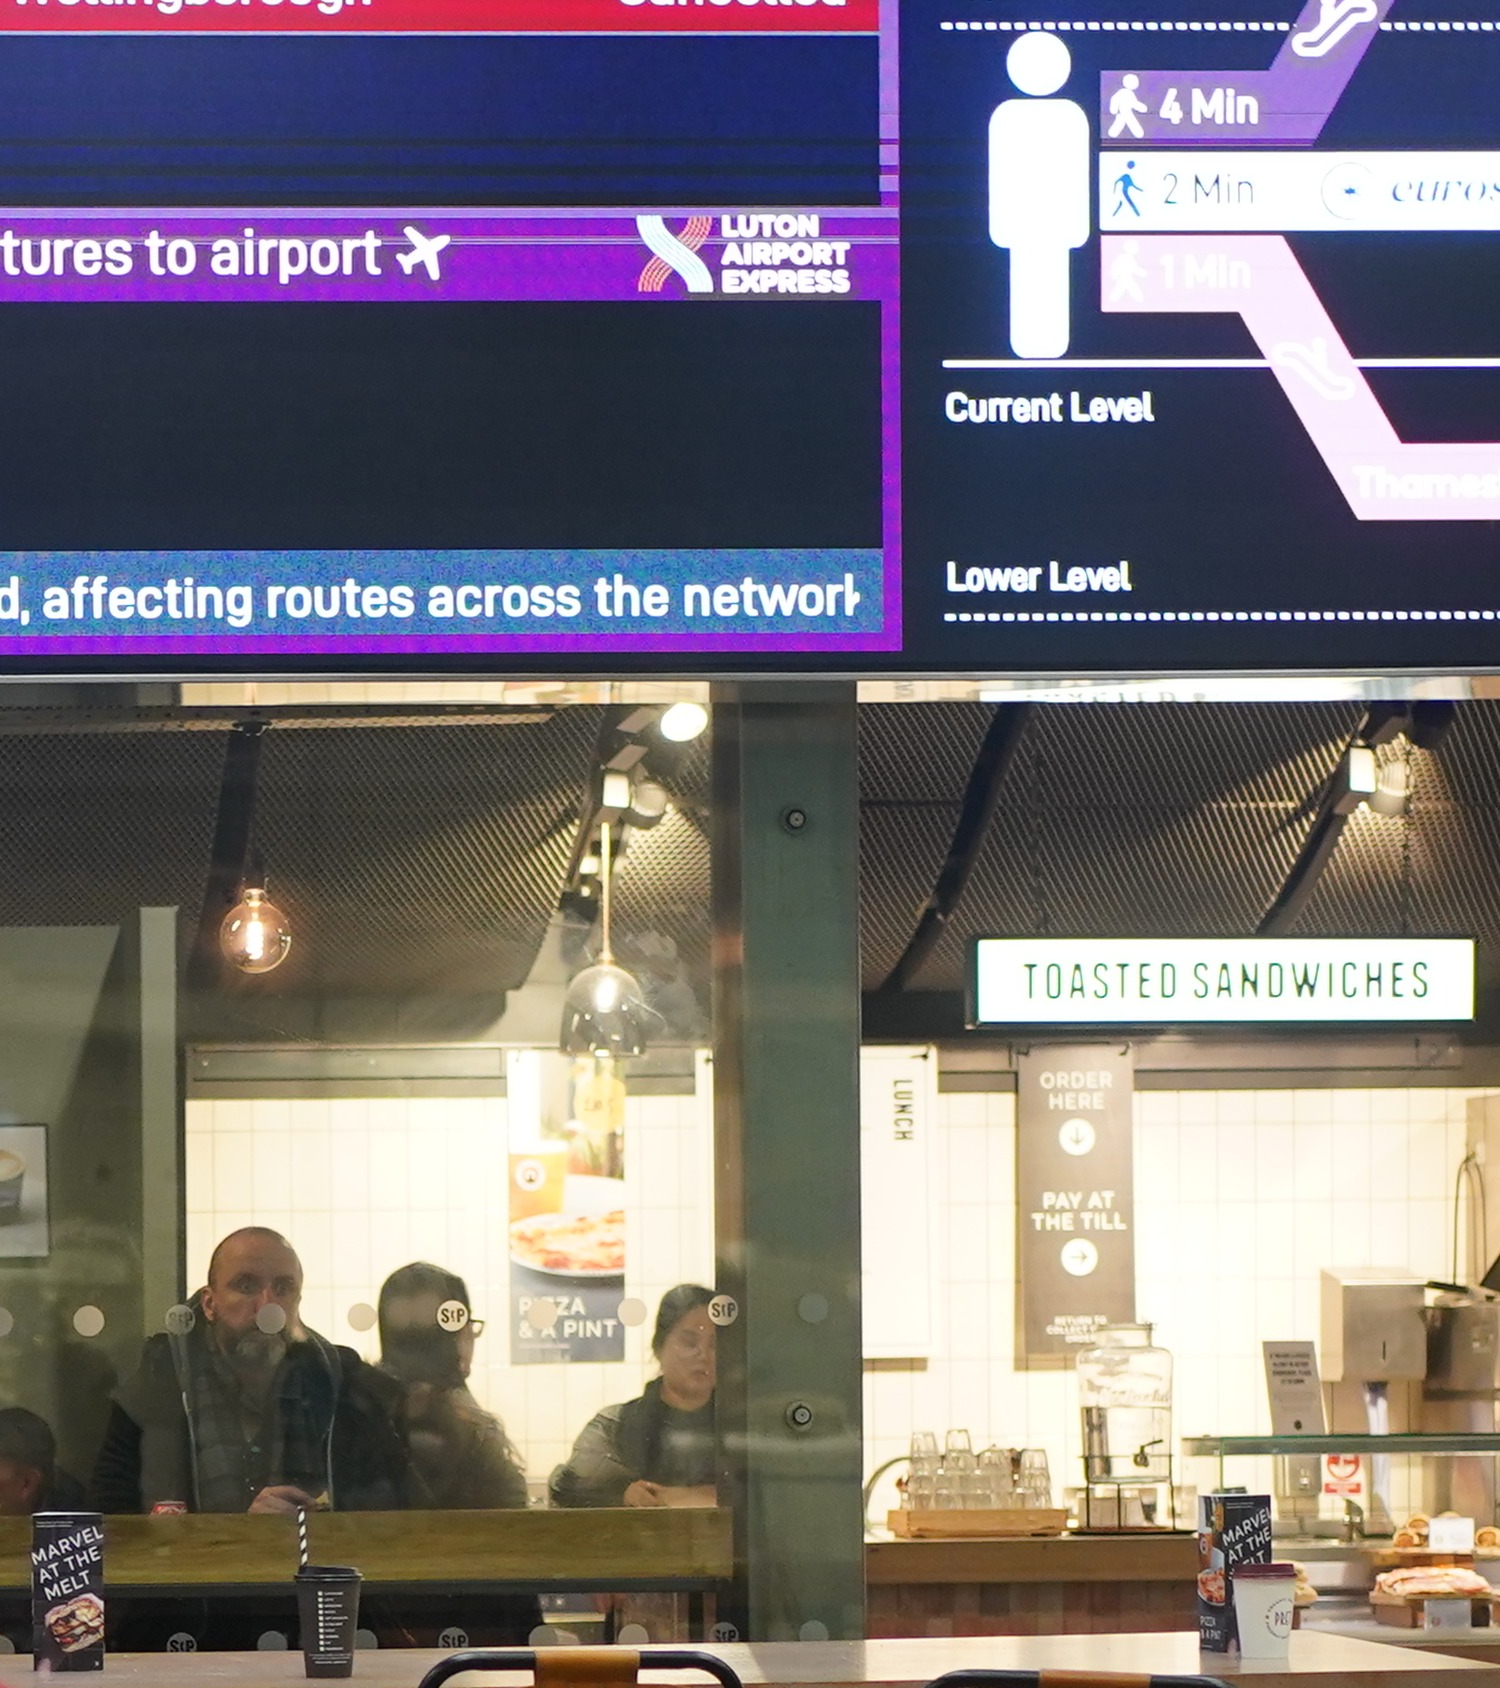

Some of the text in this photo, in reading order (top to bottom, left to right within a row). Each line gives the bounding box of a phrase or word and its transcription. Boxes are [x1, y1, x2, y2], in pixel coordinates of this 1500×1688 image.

[1158, 87, 1259, 125] 4 Min
[1163, 173, 1178, 205] 2
[1194, 173, 1255, 205] Min
[721, 213, 820, 239] LUTON
[143, 230, 203, 276] to
[210, 227, 383, 285] airport
[720, 241, 851, 266] AIRPORT
[721, 268, 851, 294] EXPRESS
[1182, 254, 1252, 288] Min
[945, 391, 1155, 423] Current Level
[947, 560, 1132, 593] Lower Level
[42, 575, 253, 628] affecting
[267, 578, 415, 619] routes
[427, 584, 582, 618] across
[593, 573, 670, 617] the
[1023, 961, 1429, 999] TOASTED SANDWICHES
[1039, 1070, 1113, 1090] ORDER
[893, 1079, 914, 1140] LUNCH
[1048, 1091, 1105, 1111] HERE
[1042, 1190, 1115, 1210] PAY AT
[1031, 1211, 1127, 1232] THE TILL
[563, 1319, 618, 1339] PINT
[31, 1525, 104, 1566] MARVEL
[1228, 1527, 1272, 1565] AT THE
[39, 1546, 102, 1584] AT THE
[44, 1570, 91, 1601] MELT
